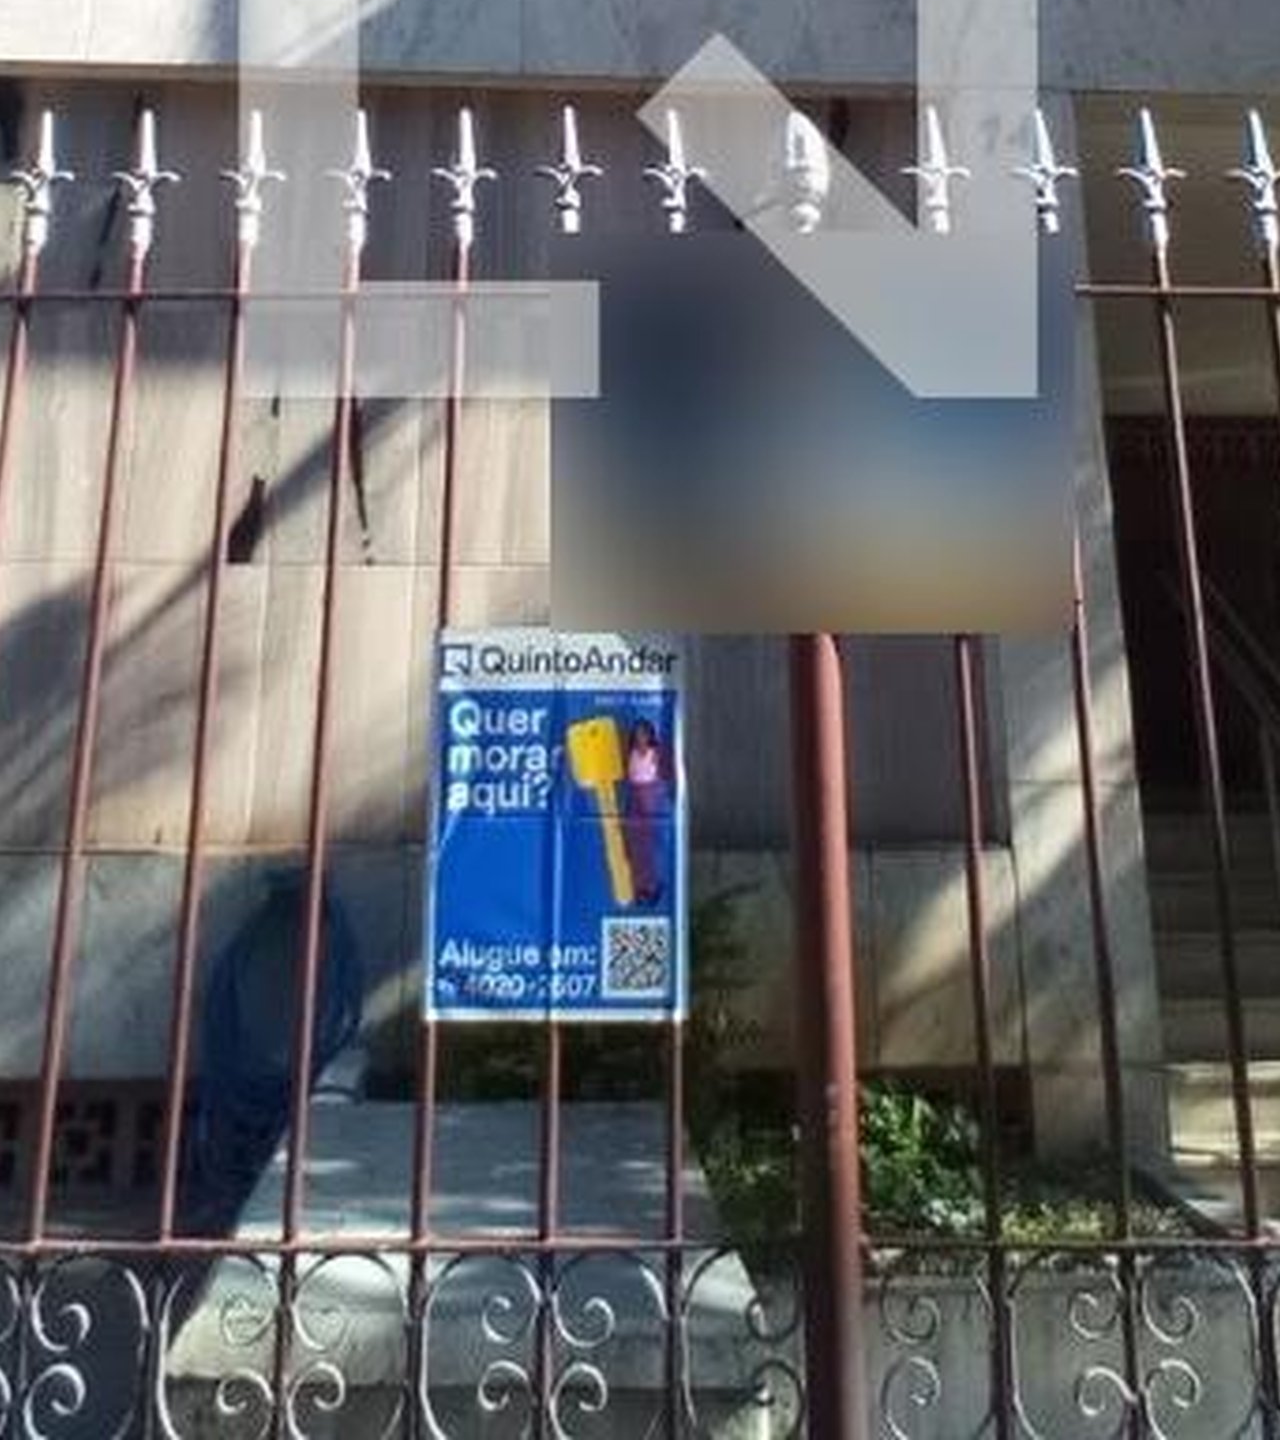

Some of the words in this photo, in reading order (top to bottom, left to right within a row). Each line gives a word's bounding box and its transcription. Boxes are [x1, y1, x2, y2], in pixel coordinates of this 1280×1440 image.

[479, 644, 678, 675] QuintoAndar
[449, 698, 548, 738] Quer
[447, 771, 552, 816] aqui?
[438, 937, 541, 973] Alugue
